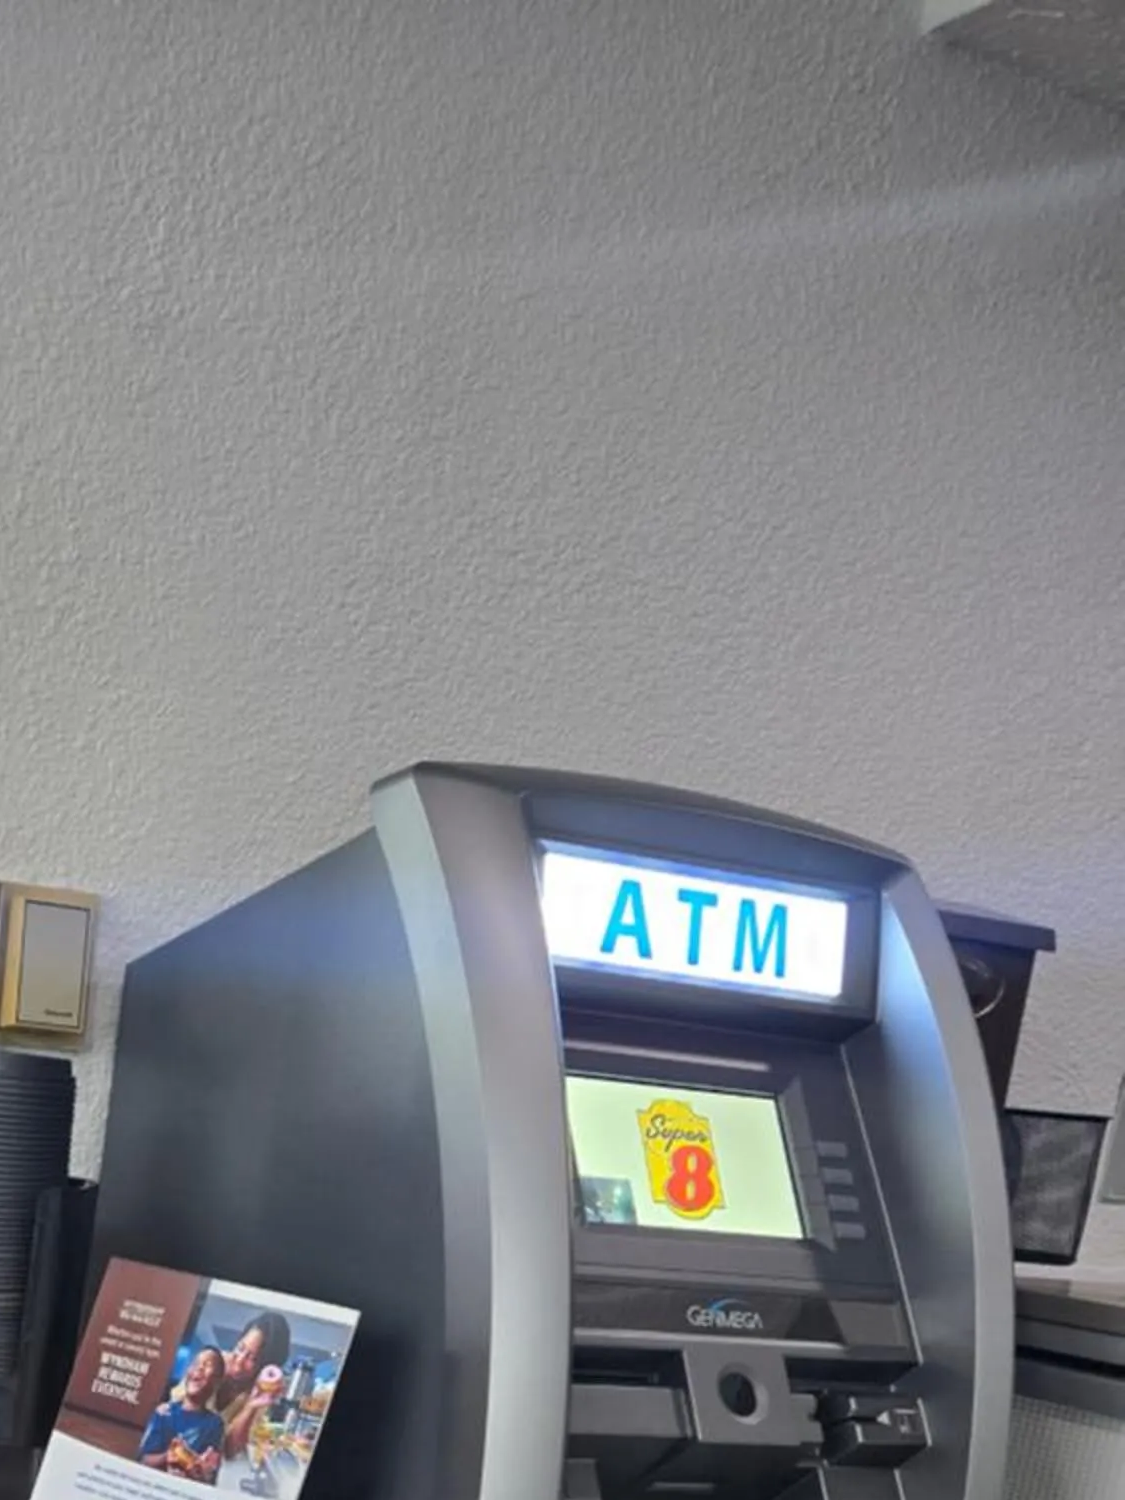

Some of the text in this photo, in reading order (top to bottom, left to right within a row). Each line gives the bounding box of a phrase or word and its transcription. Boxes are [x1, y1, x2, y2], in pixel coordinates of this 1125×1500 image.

[600, 880, 789, 979] ATM
[646, 1113, 707, 1152] Super
[666, 1144, 716, 1212] 8
